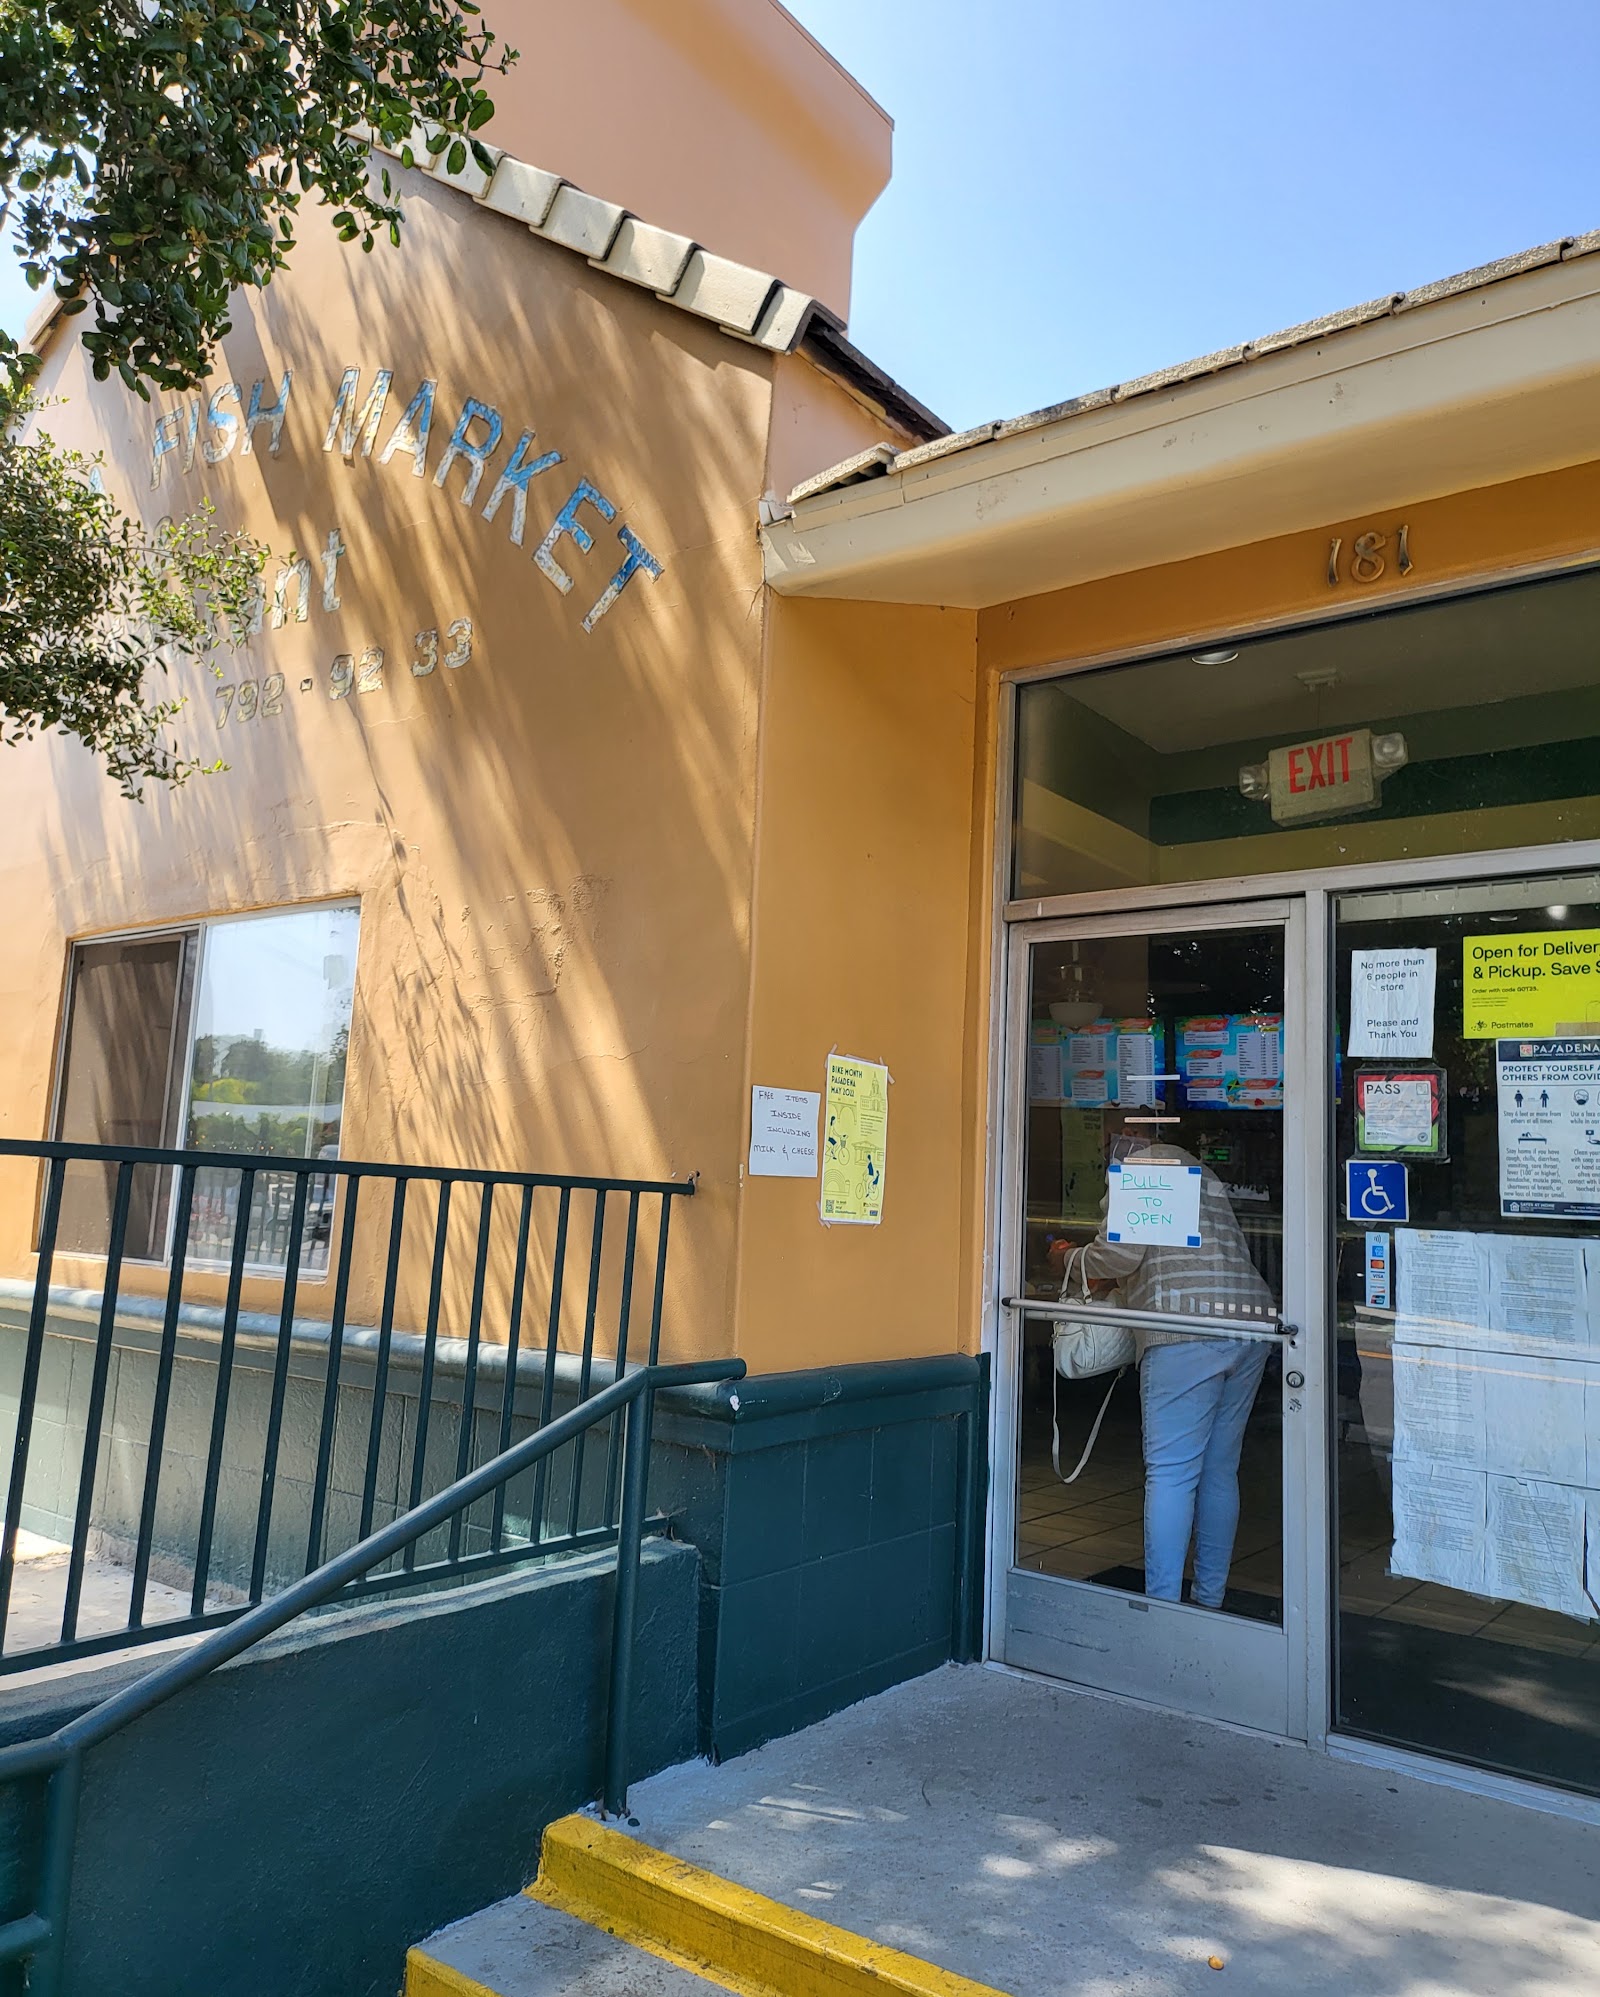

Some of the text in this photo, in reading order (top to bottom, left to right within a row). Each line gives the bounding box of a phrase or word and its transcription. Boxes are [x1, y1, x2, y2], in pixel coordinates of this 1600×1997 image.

[151, 368, 293, 491] FISH
[322, 366, 665, 634] MARKET
[1328, 525, 1413, 588] 181
[216, 673, 285, 730] 792
[1288, 737, 1353, 794] EXIT
[1472, 941, 1600, 962] Open for Deliver
[1360, 958, 1425, 970] No more than
[1366, 970, 1418, 982] 6 people in
[1473, 966, 1483, 979] &
[1489, 964, 1546, 980] Pickup.
[1551, 962, 1591, 976] Save
[1380, 983, 1404, 992] store
[1366, 1018, 1419, 1027] Please and
[1491, 1021, 1534, 1029] Postmates
[1368, 1029, 1417, 1039] Thank You
[1533, 1043, 1600, 1054] PASADENA
[831, 1065, 863, 1079] BIKE MONTH
[1502, 1065, 1543, 1073] PROTECT
[1545, 1064, 1594, 1072] YOURSELF
[1501, 1073, 1539, 1081] OTHERS
[1541, 1073, 1570, 1081] FROM
[1366, 1084, 1401, 1095] PASS
[784, 1094, 809, 1104] ITEMS
[770, 1109, 802, 1120] INSIDE
[766, 1126, 811, 1138] INCLUDING
[753, 1144, 776, 1153] MILK
[791, 1147, 815, 1156] CHEESE
[1122, 1173, 1171, 1189] PULL
[1137, 1196, 1162, 1208] TO
[1127, 1211, 1172, 1225] OPEN
